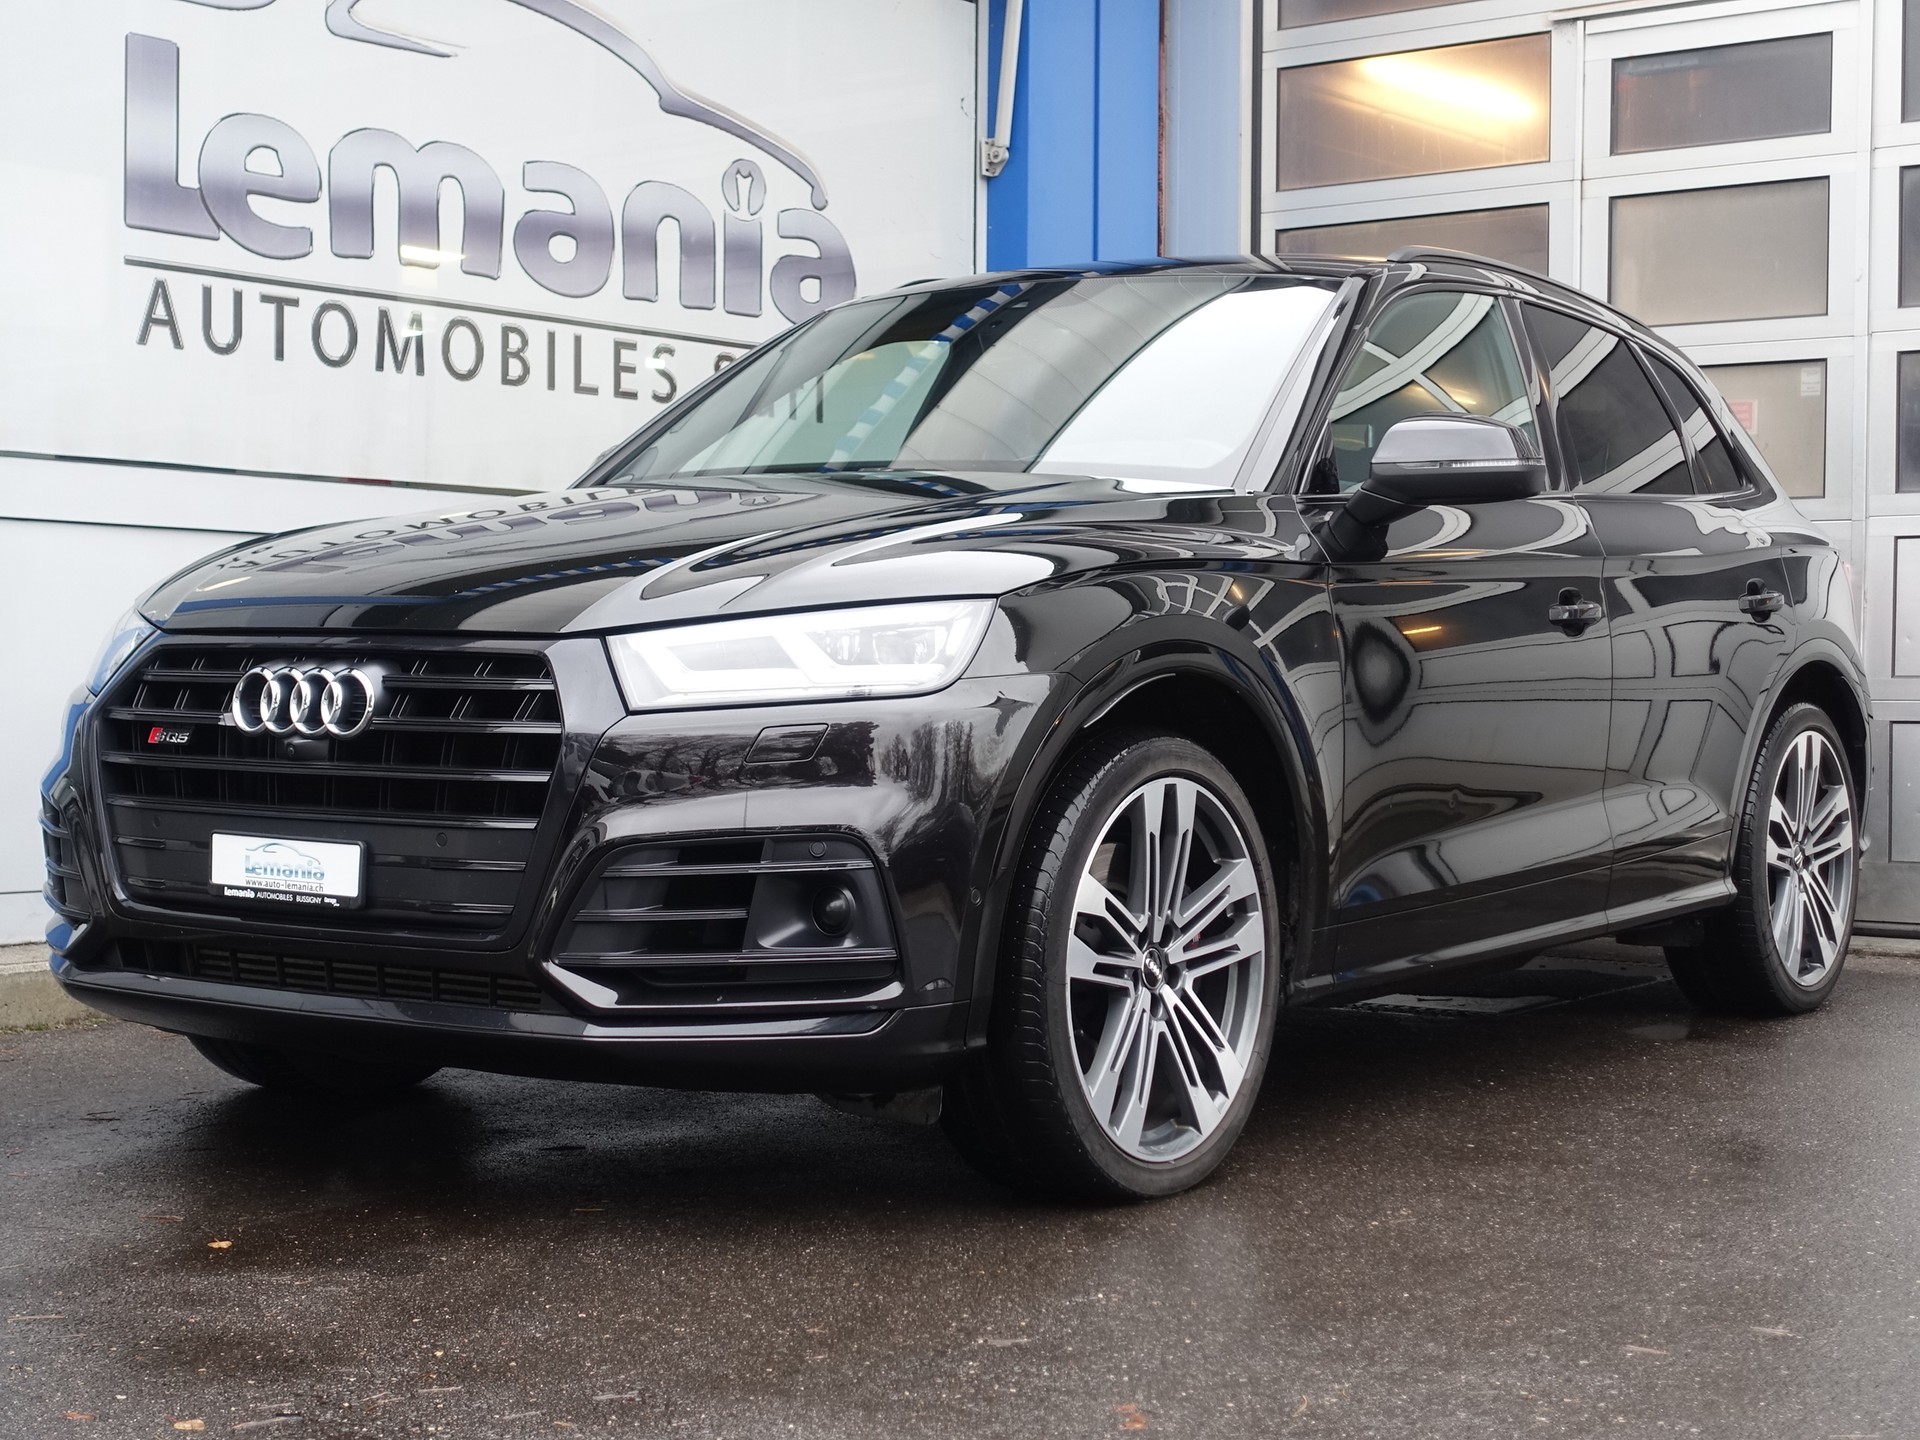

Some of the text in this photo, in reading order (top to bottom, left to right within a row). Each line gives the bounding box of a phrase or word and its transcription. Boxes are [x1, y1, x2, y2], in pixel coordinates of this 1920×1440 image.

[137, 278, 677, 403] AUTOMOBILES
[150, 729, 190, 744] SQ5
[245, 878, 324, 892] www.auto-lemania.ch
[256, 892, 293, 902] AUTOMOBILES
[296, 895, 322, 905] BUSSIGNY
